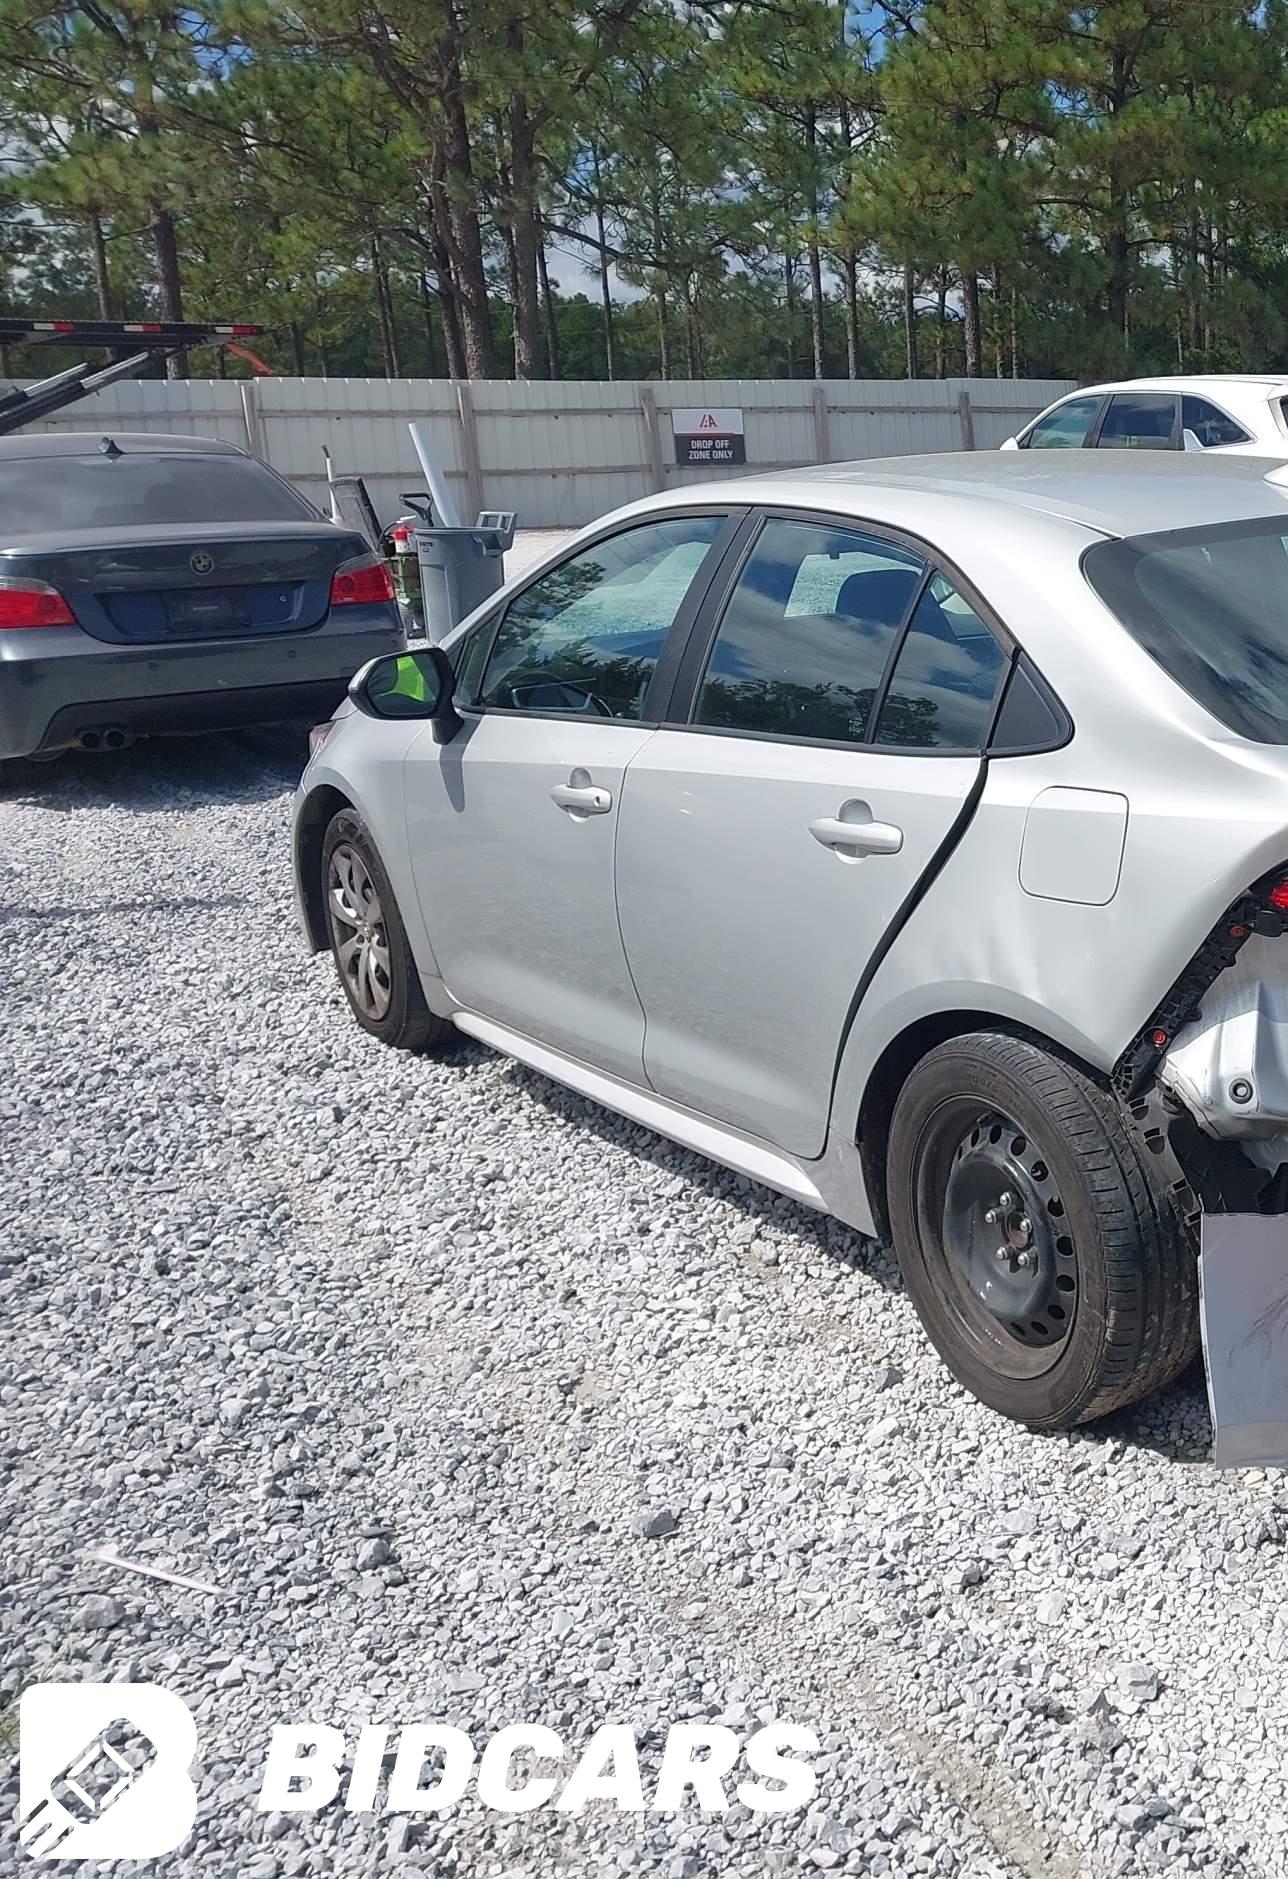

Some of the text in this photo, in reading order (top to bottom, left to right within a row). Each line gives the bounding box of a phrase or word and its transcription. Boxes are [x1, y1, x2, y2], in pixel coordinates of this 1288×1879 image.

[691, 439, 730, 449] DROP OFF
[688, 450, 734, 460] ZONE ONLY
